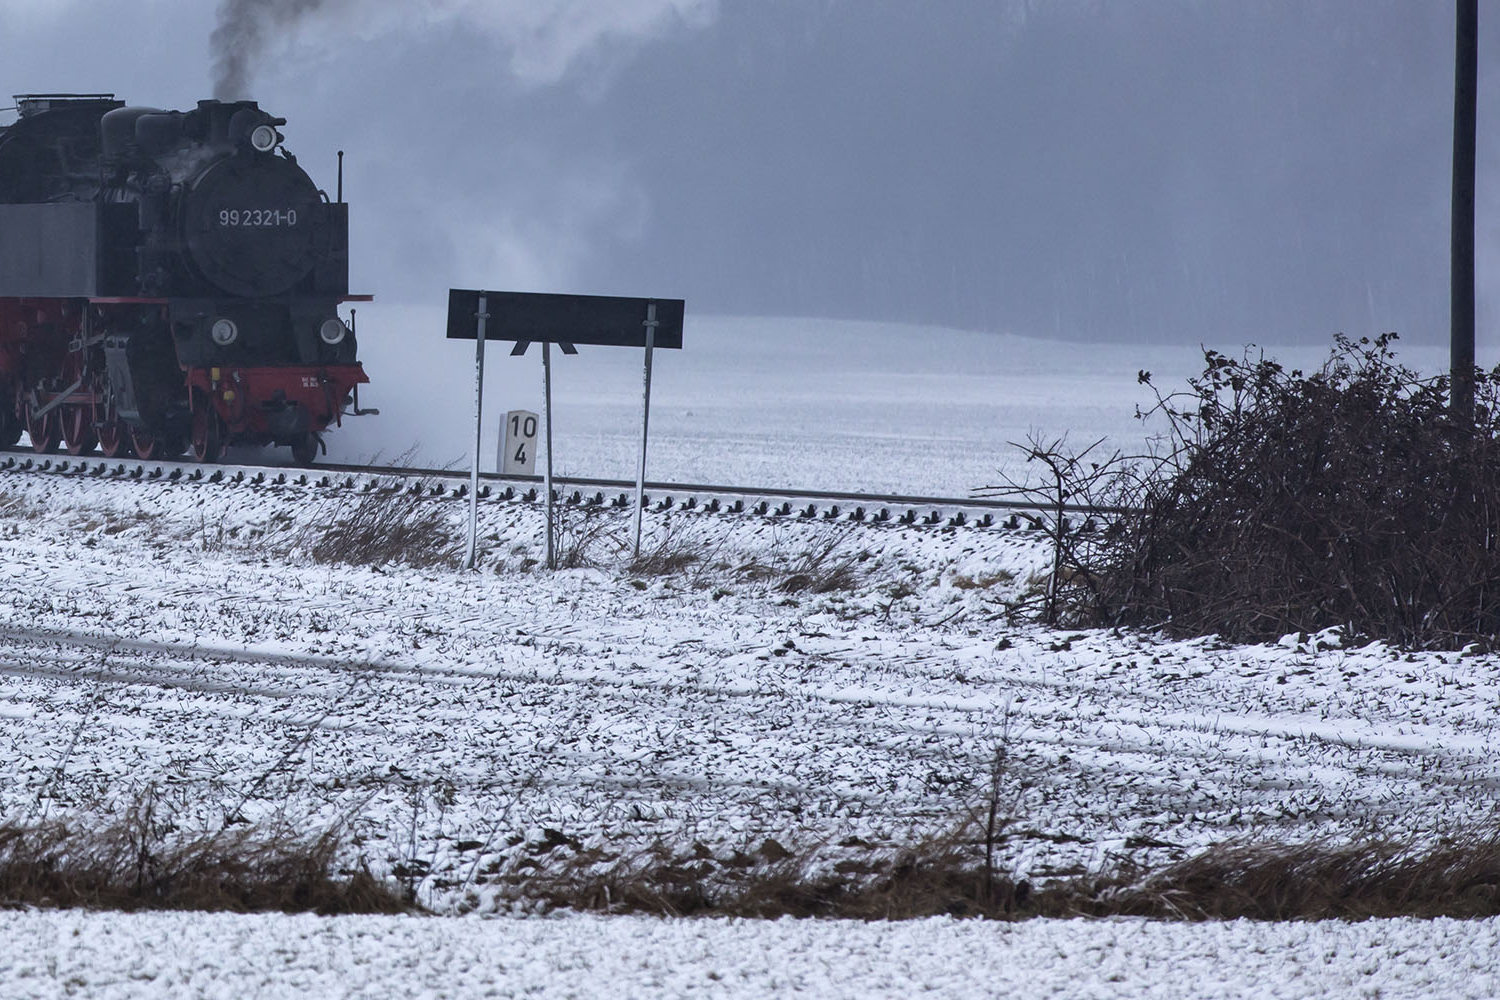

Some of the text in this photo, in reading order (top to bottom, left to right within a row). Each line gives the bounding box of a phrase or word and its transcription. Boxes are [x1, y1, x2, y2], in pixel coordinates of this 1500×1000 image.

[219, 209, 297, 226] 99 2321-0
[511, 415, 537, 438] 10
[514, 442, 527, 465] 4
